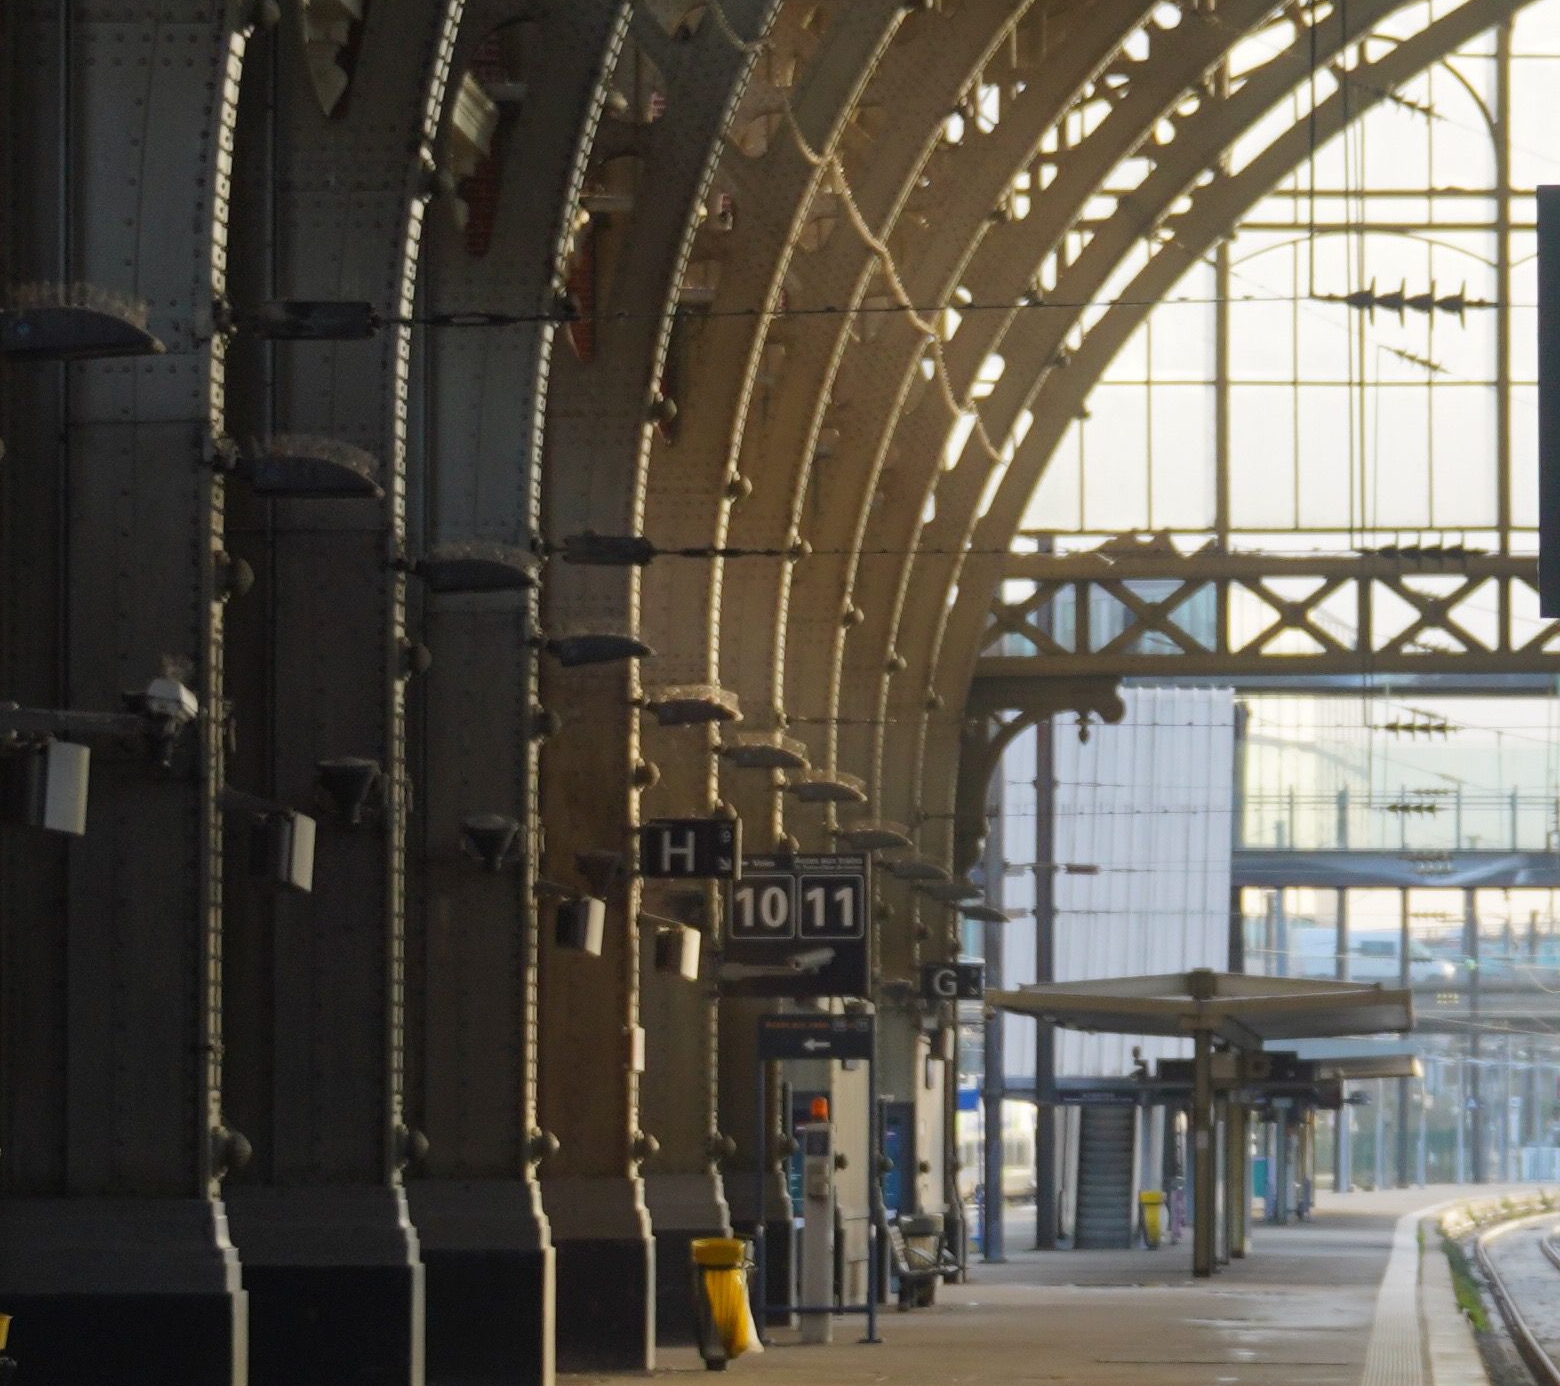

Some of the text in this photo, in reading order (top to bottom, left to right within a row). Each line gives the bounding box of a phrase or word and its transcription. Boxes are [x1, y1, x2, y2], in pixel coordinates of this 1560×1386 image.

[662, 831, 695, 872] H
[735, 886, 854, 928] 10 11
[934, 968, 958, 996] G
